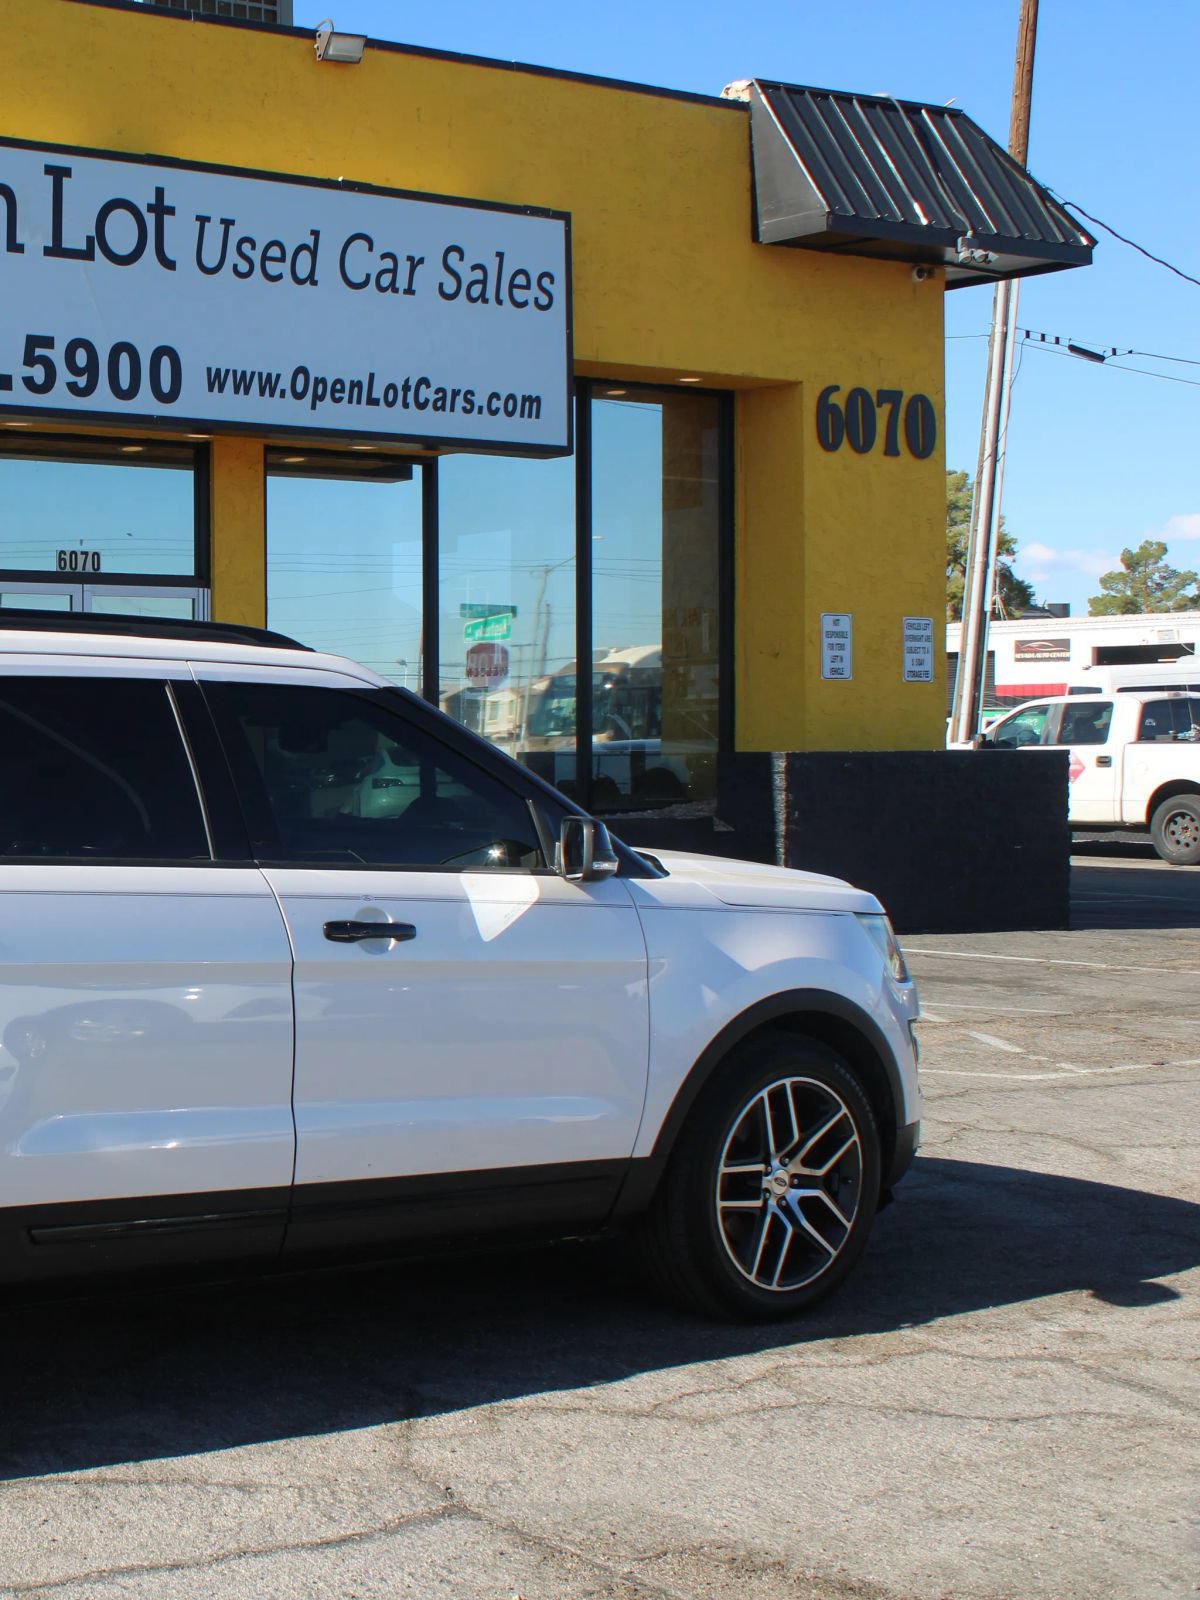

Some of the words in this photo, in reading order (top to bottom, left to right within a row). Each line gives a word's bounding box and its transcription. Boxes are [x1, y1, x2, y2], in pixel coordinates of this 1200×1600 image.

[43, 164, 177, 271] Lot
[195, 214, 320, 286] Used
[339, 233, 425, 296] Car
[438, 244, 555, 311] Sales
[206, 365, 542, 420] www.OpenLotCars.com
[816, 385, 937, 459] 6070
[57, 550, 101, 573] 6070
